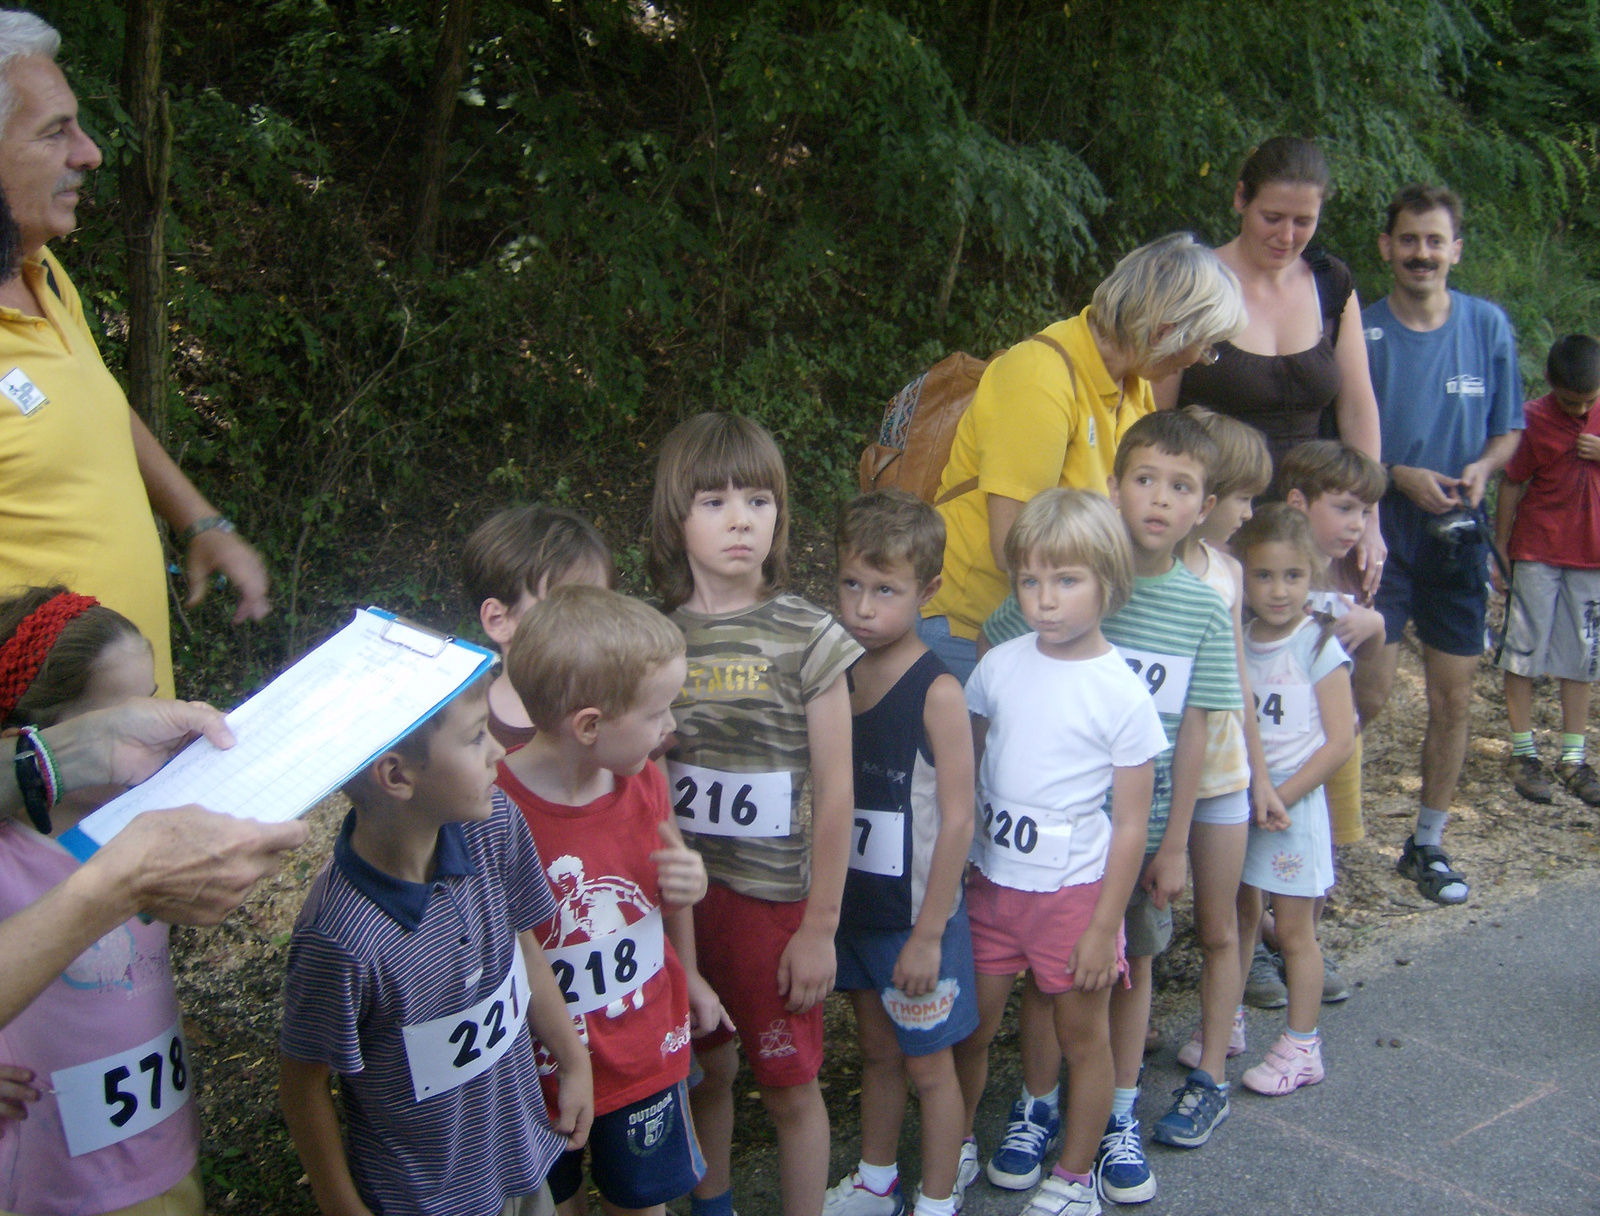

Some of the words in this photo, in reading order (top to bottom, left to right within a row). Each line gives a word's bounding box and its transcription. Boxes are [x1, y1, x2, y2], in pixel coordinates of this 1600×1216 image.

[674, 776, 758, 826] 216
[551, 938, 637, 1004] 218
[448, 975, 519, 1068] 221
[104, 1036, 187, 1128] 578
